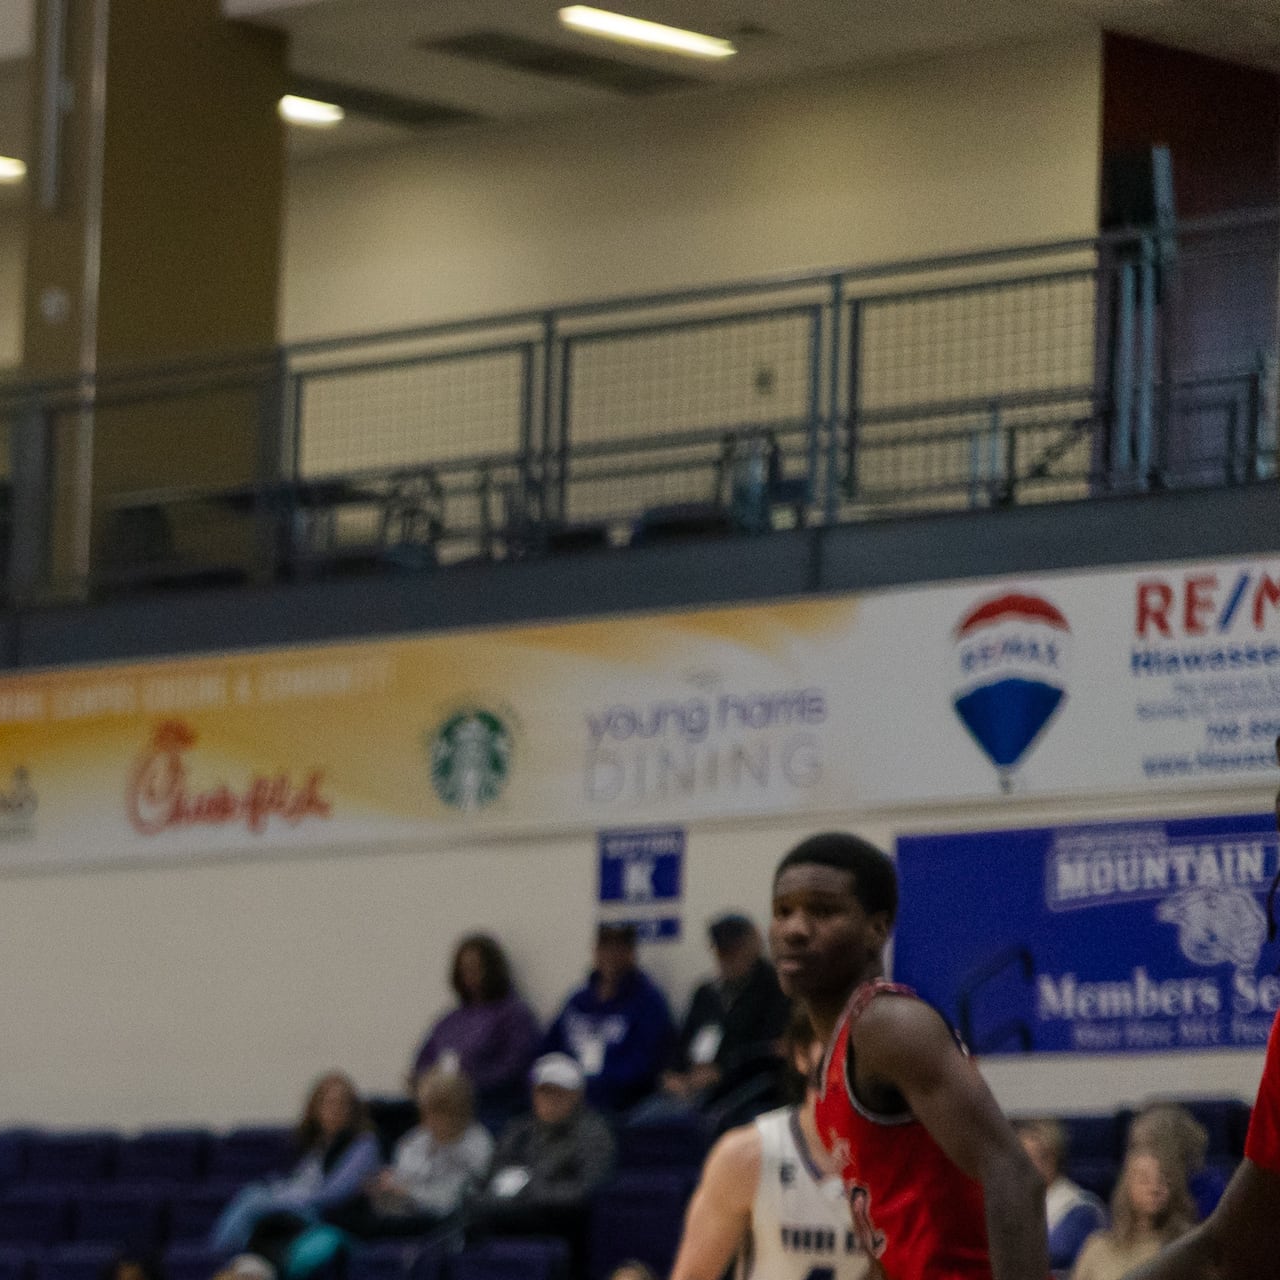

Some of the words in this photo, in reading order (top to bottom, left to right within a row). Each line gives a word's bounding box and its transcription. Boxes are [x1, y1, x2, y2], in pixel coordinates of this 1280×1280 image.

[585, 696, 710, 747] young
[584, 731, 824, 803] DINING
[1056, 841, 1266, 900] MOUNTAIN
[1038, 966, 1222, 1020] Members
